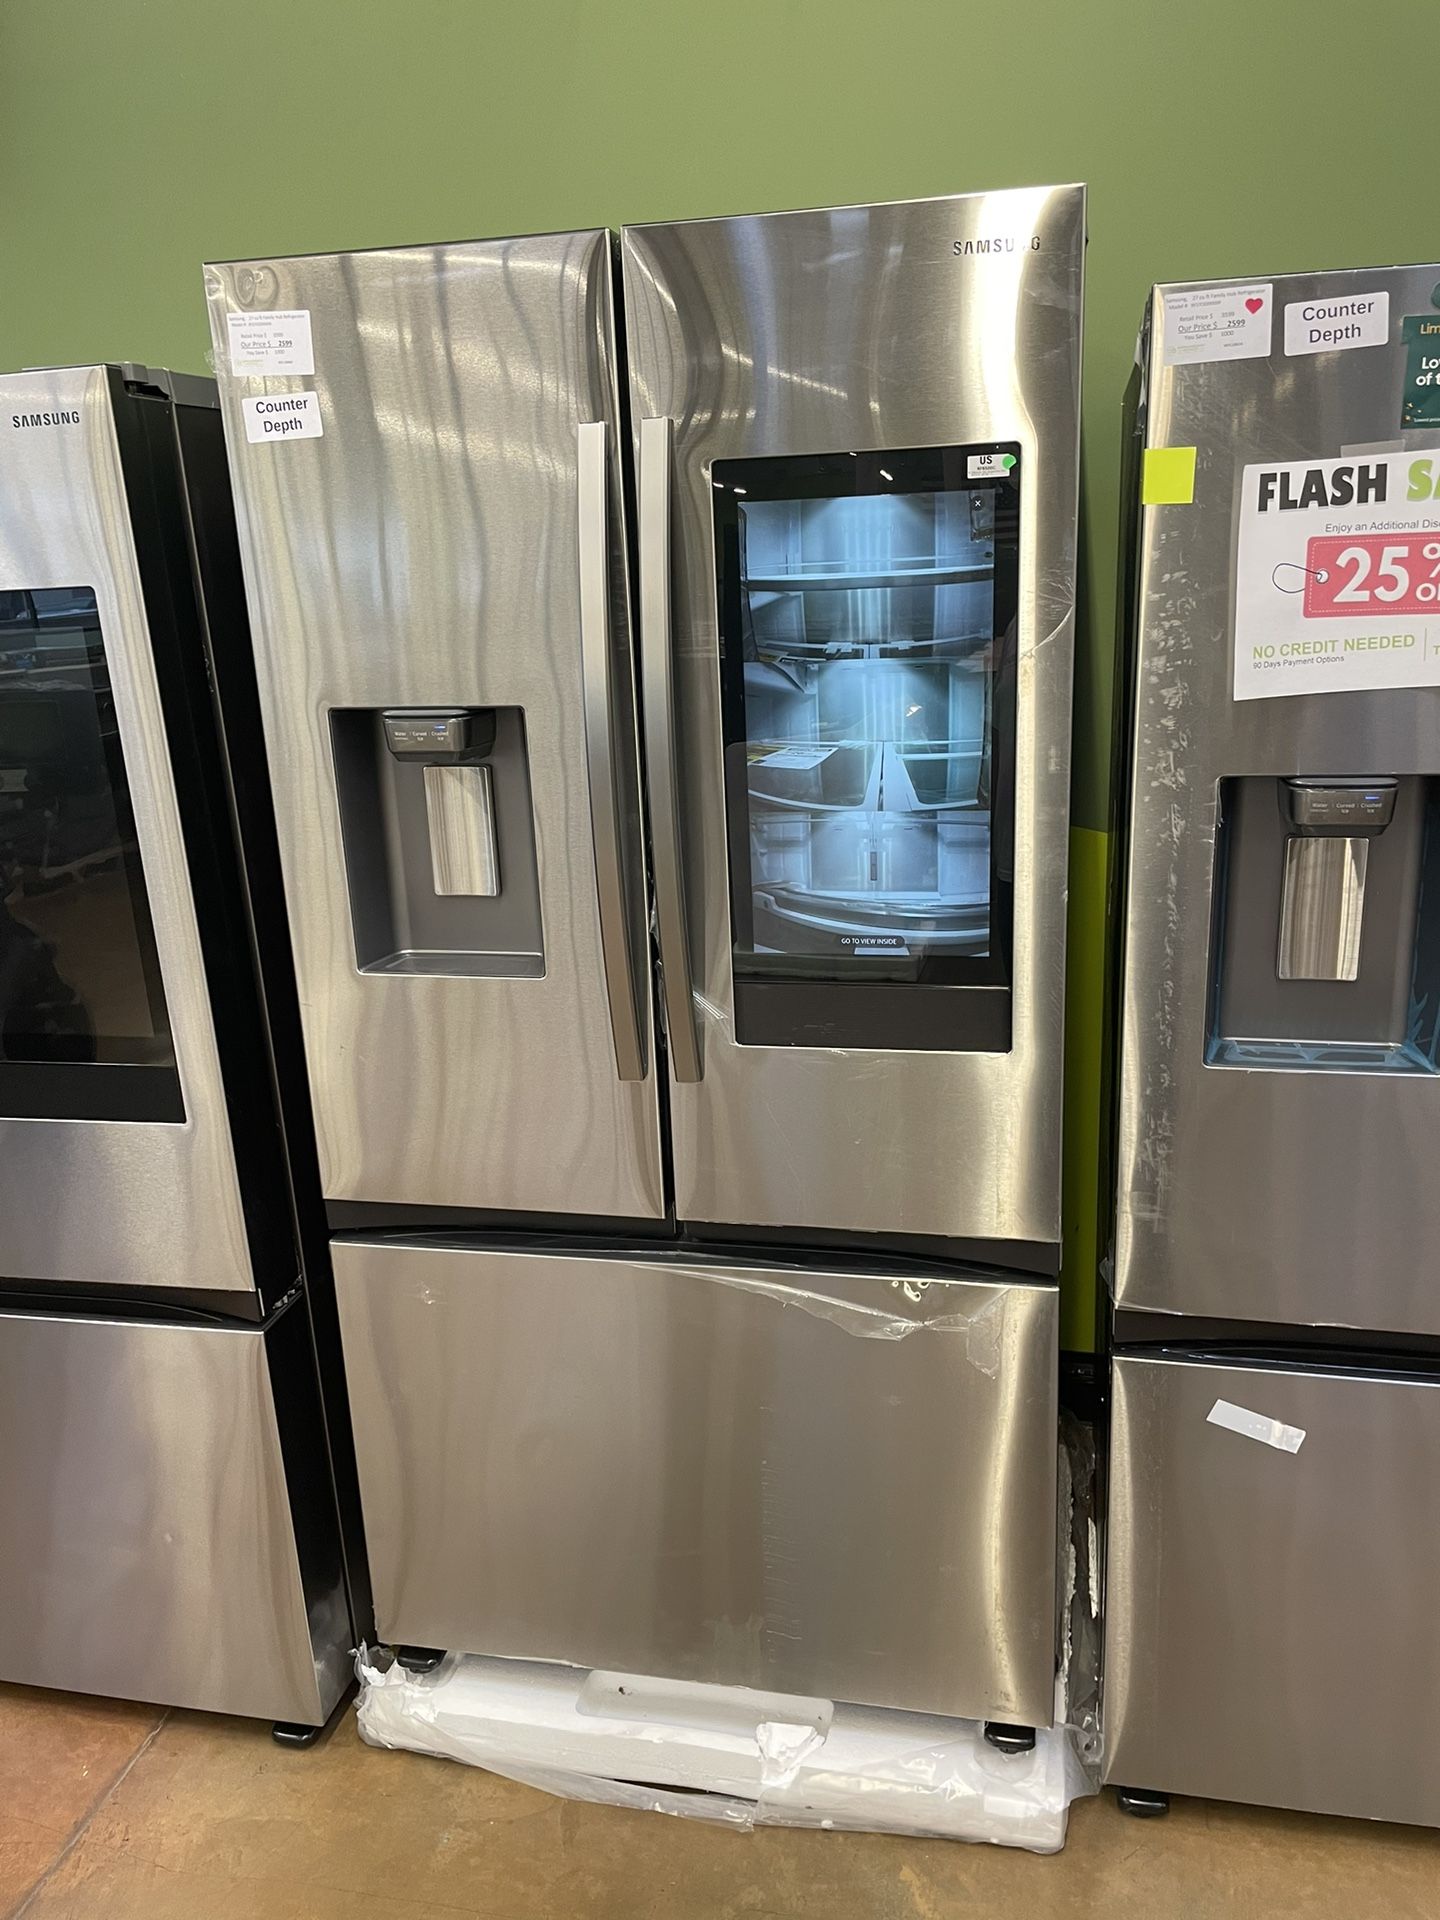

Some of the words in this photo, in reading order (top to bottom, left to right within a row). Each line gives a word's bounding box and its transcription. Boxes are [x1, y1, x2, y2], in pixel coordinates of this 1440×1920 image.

[953, 236, 1040, 256] SAMSUG
[1302, 302, 1375, 321] Counter
[1178, 324, 1192, 332] Our
[1227, 319, 1246, 328] 2599
[1309, 323, 1361, 344] Depth
[1422, 356, 1440, 369] Lo
[1415, 372, 1433, 386] of
[256, 399, 308, 414] Counter
[12, 411, 80, 428] SAMSUNG
[263, 417, 303, 434] Depth
[979, 455, 993, 465] US
[1258, 463, 1388, 512] FLASH
[1325, 523, 1352, 534] Enjoy
[1355, 523, 1368, 531] an
[1370, 519, 1419, 531] Additional
[1253, 645, 1275, 659] NO
[1280, 639, 1339, 656] CREDIT
[1344, 635, 1416, 652] NEEDED
[1264, 660, 1281, 669] Days
[1283, 658, 1314, 668] Payment
[1316, 655, 1345, 665] Options
[841, 937, 851, 945] GO
[860, 937, 876, 945] VIEW
[876, 937, 897, 945] INSIDE
